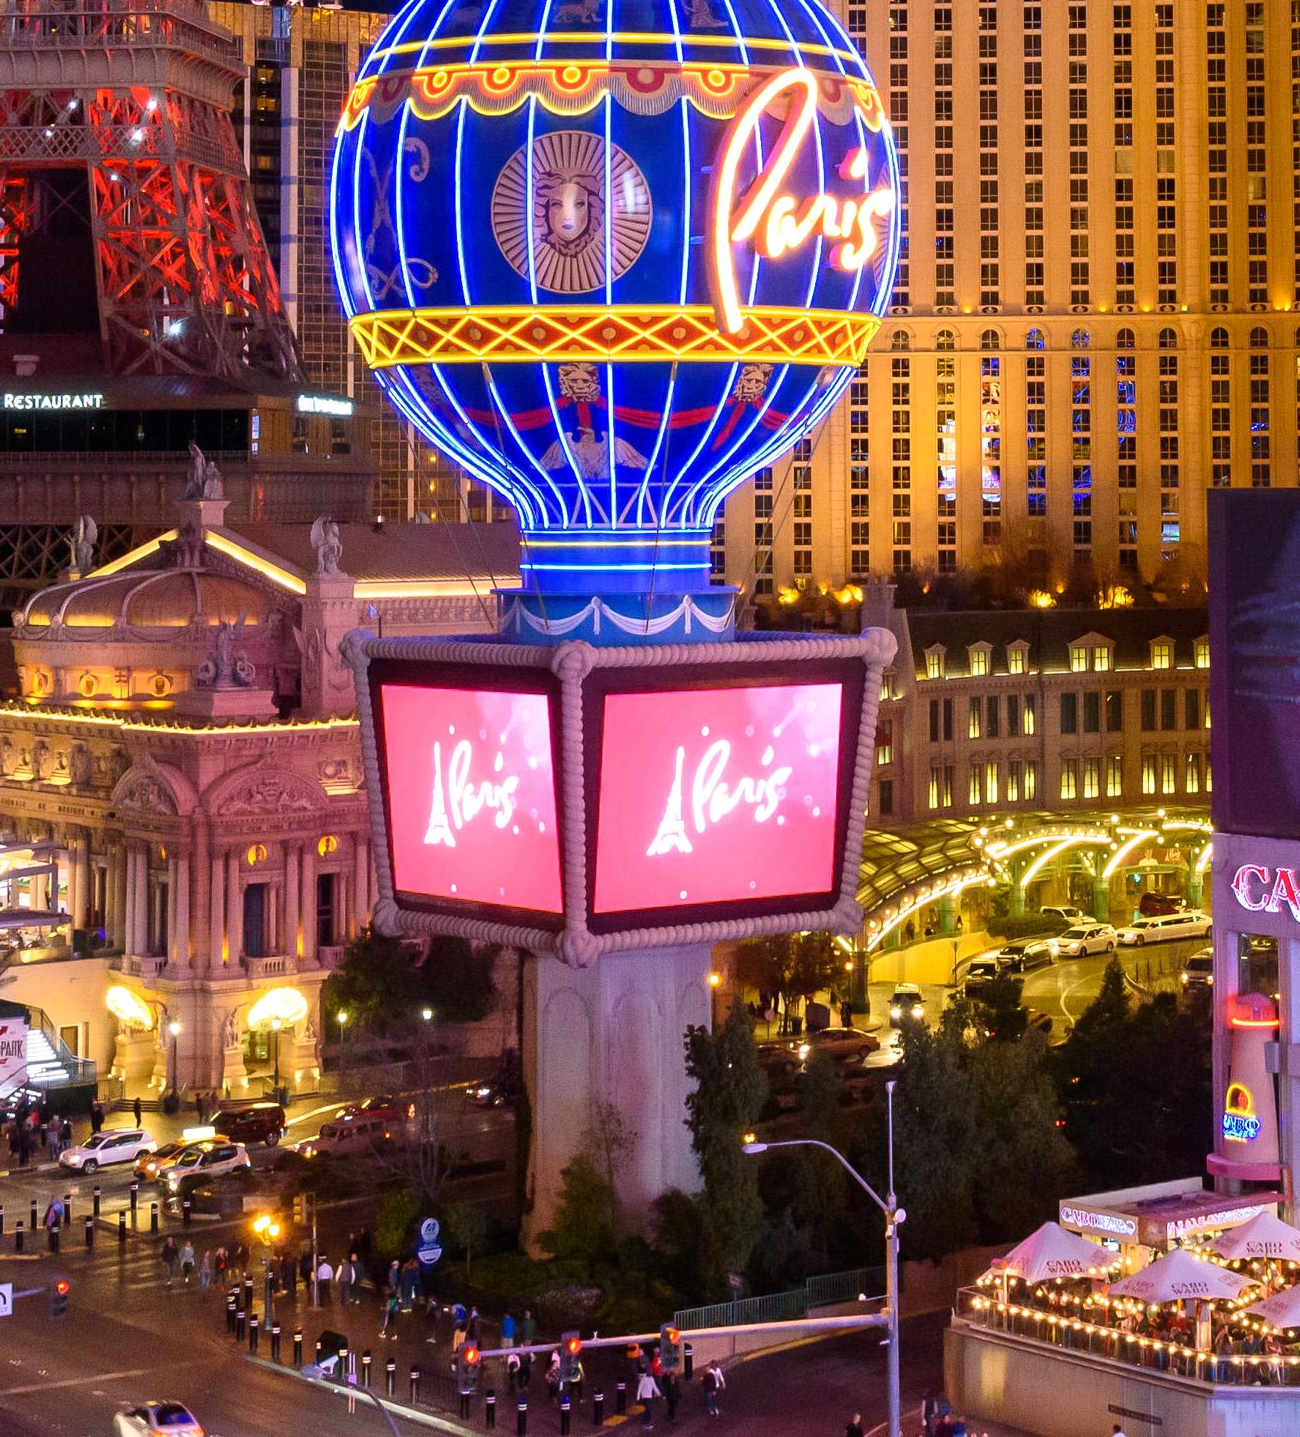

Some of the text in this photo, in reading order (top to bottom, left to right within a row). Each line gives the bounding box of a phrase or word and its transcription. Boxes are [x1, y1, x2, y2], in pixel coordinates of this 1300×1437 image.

[713, 67, 893, 333] Paris
[4, 394, 103, 409] RESTAURANT
[449, 740, 520, 829] Paris
[692, 739, 793, 833] Paris
[0, 1040, 23, 1058] PARK
